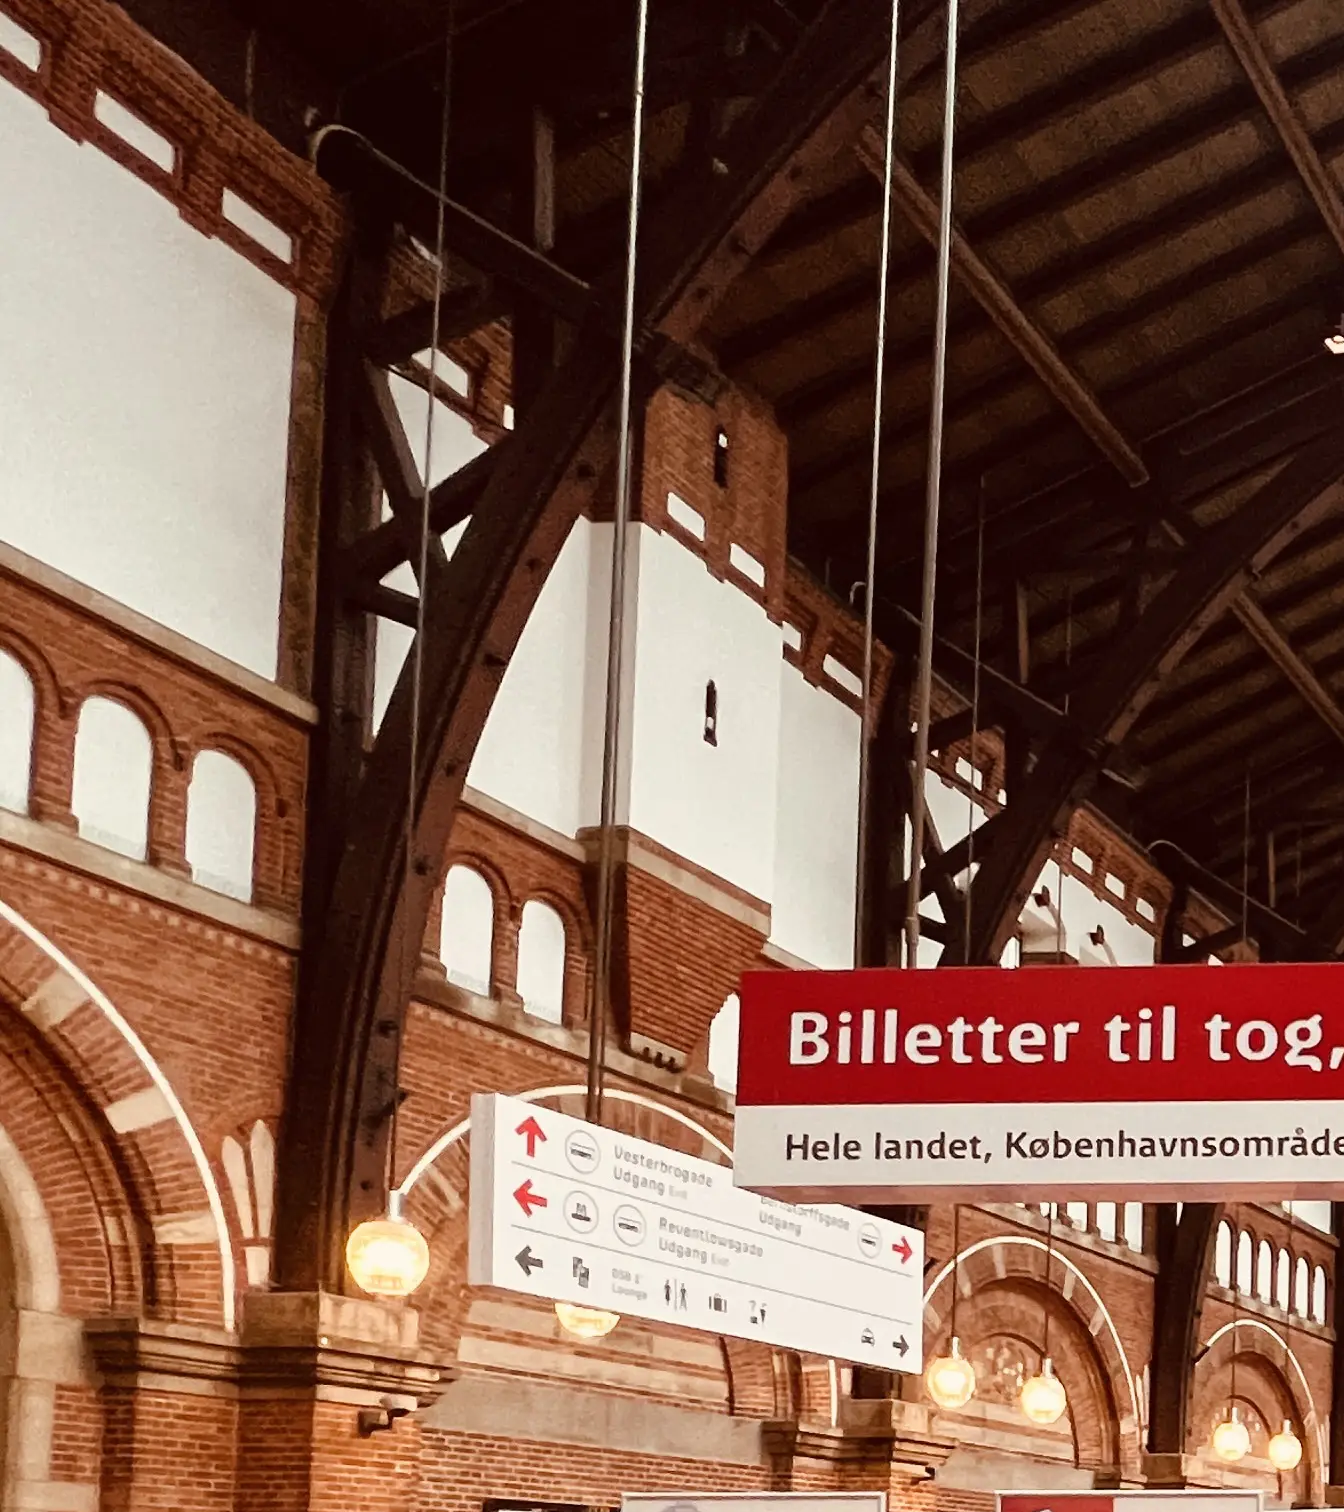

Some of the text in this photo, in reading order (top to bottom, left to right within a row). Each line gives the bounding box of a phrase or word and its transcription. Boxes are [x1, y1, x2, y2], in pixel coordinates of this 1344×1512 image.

[790, 1009, 1079, 1064] Billetter
[1104, 1006, 1175, 1061] til
[1205, 1014, 1344, 1071] tog,
[787, 1133, 861, 1160] Hele
[875, 1132, 991, 1163] landet,
[614, 1145, 713, 1187] Vesterbrogade
[614, 1167, 665, 1196] Udgang
